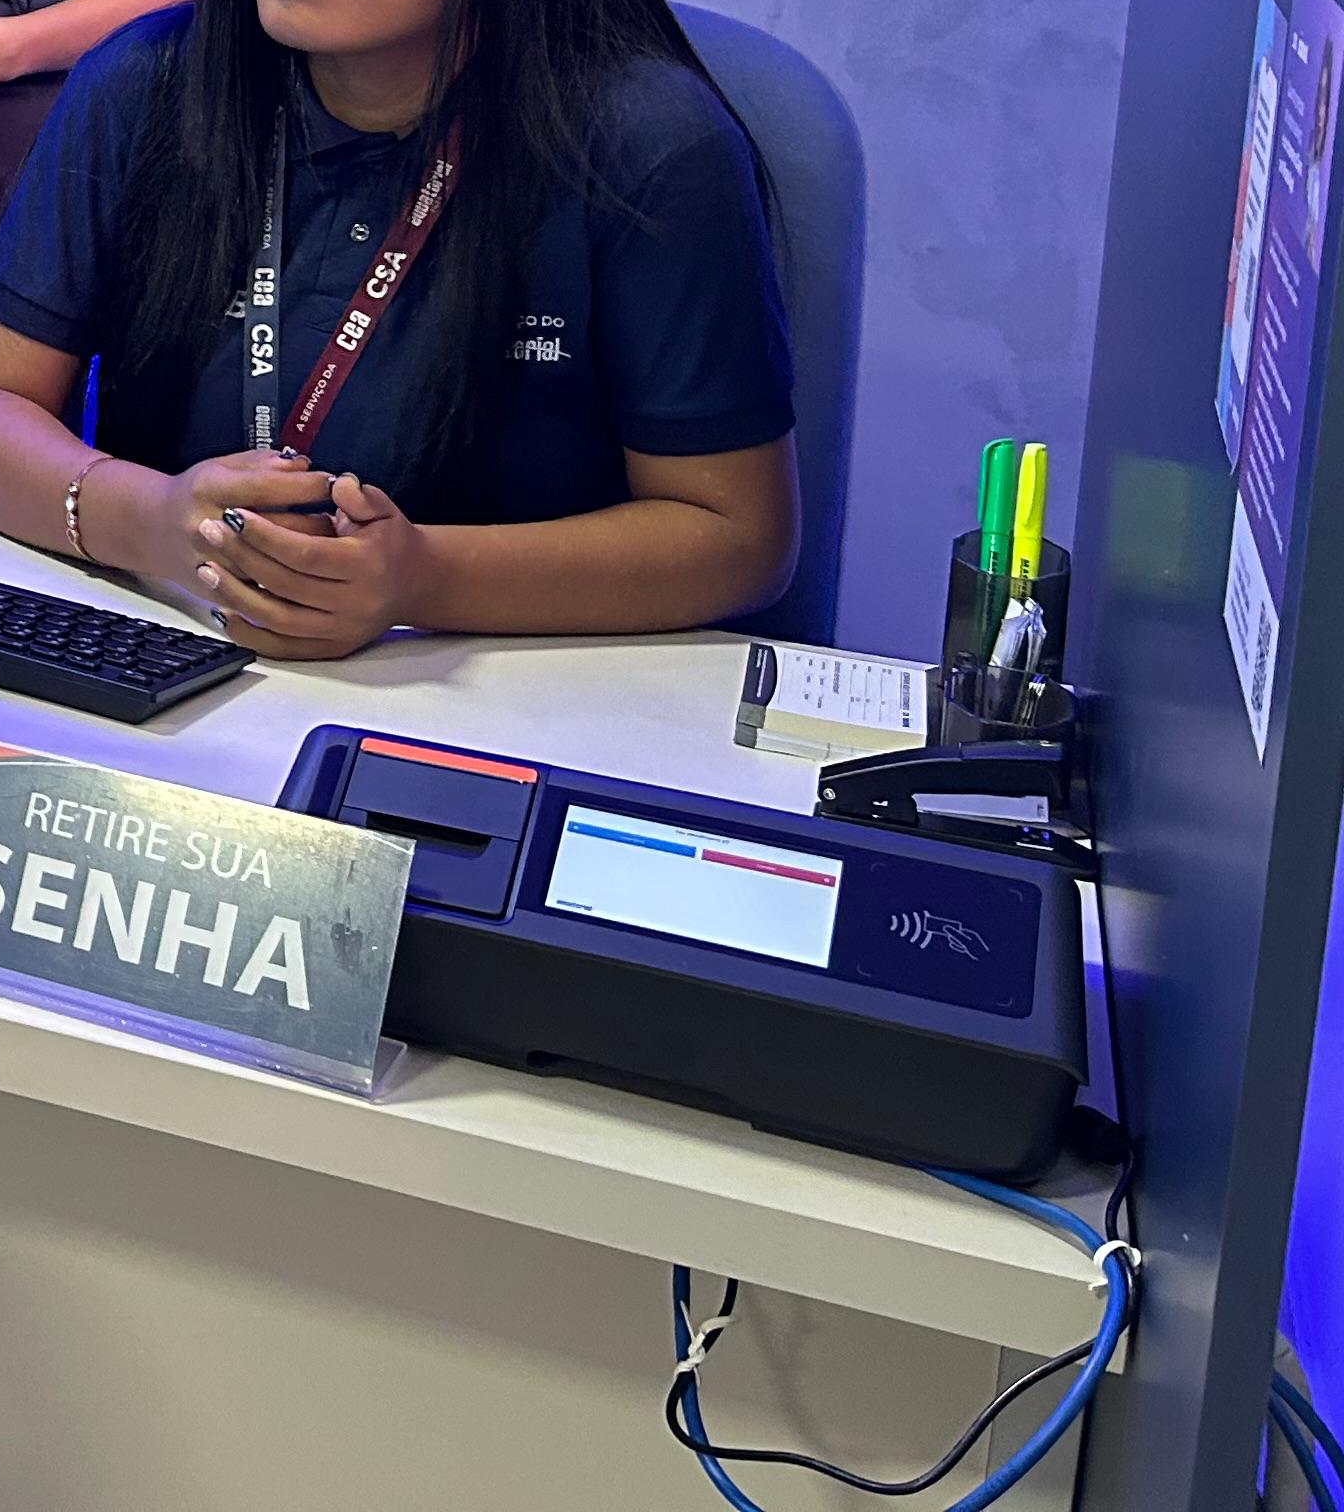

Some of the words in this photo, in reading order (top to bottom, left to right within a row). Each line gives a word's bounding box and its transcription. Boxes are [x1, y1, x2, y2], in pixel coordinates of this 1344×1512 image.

[252, 267, 275, 307] cea
[366, 249, 408, 300] CSA
[250, 323, 274, 377] CSA
[335, 309, 372, 352] cea
[300, 380, 329, 425] SERVIÇO
[323, 362, 337, 381] DA
[23, 791, 172, 863] RETIRE
[180, 832, 272, 888] SUA
